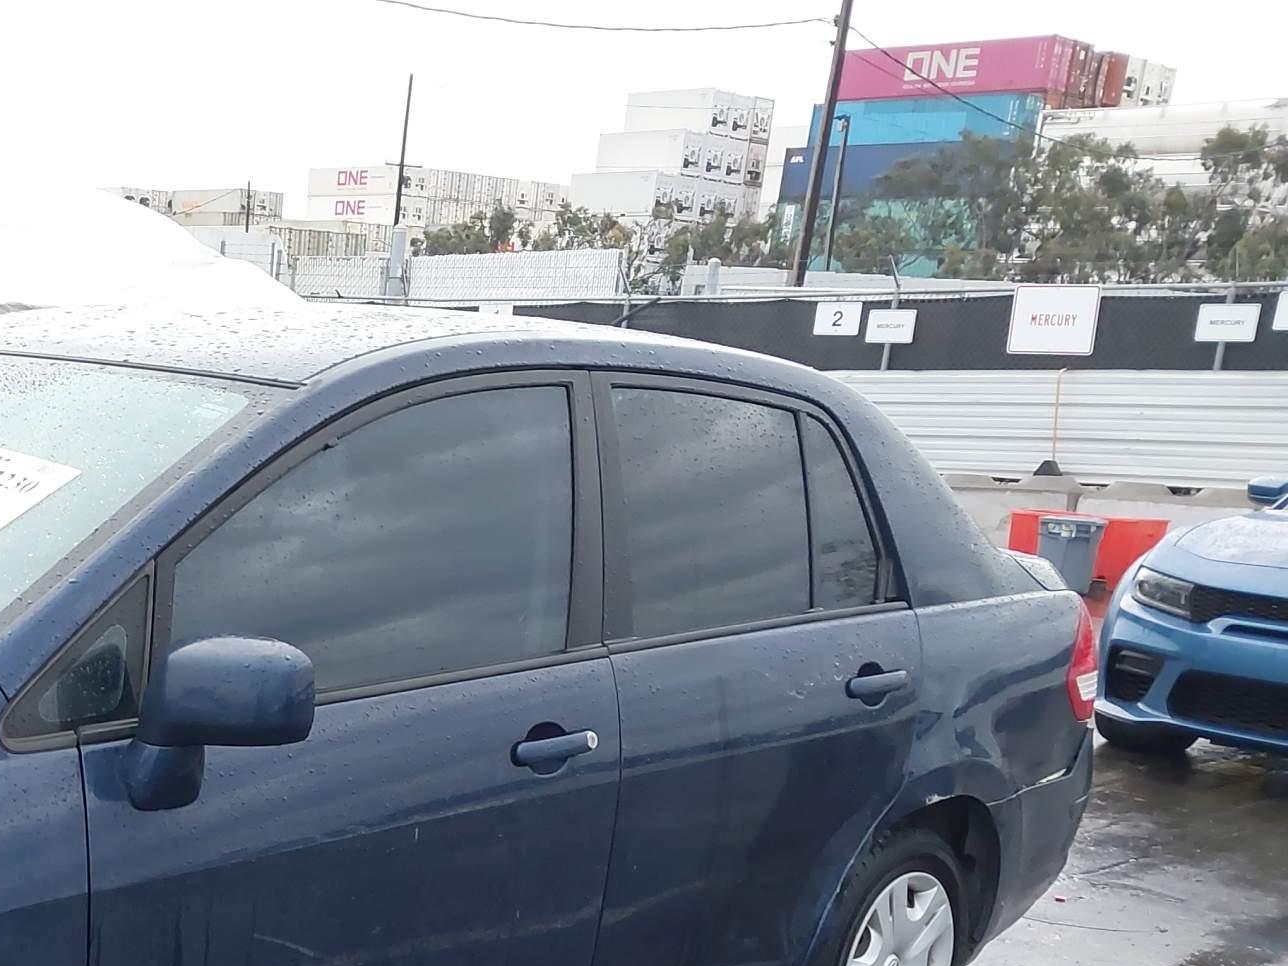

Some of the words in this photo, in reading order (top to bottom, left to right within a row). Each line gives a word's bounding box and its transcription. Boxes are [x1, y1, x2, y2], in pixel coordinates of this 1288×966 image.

[904, 48, 980, 81] ONE
[336, 170, 368, 186] ONE
[334, 200, 366, 216] ONE
[831, 311, 844, 327] 2
[1030, 313, 1078, 327] MERCURY
